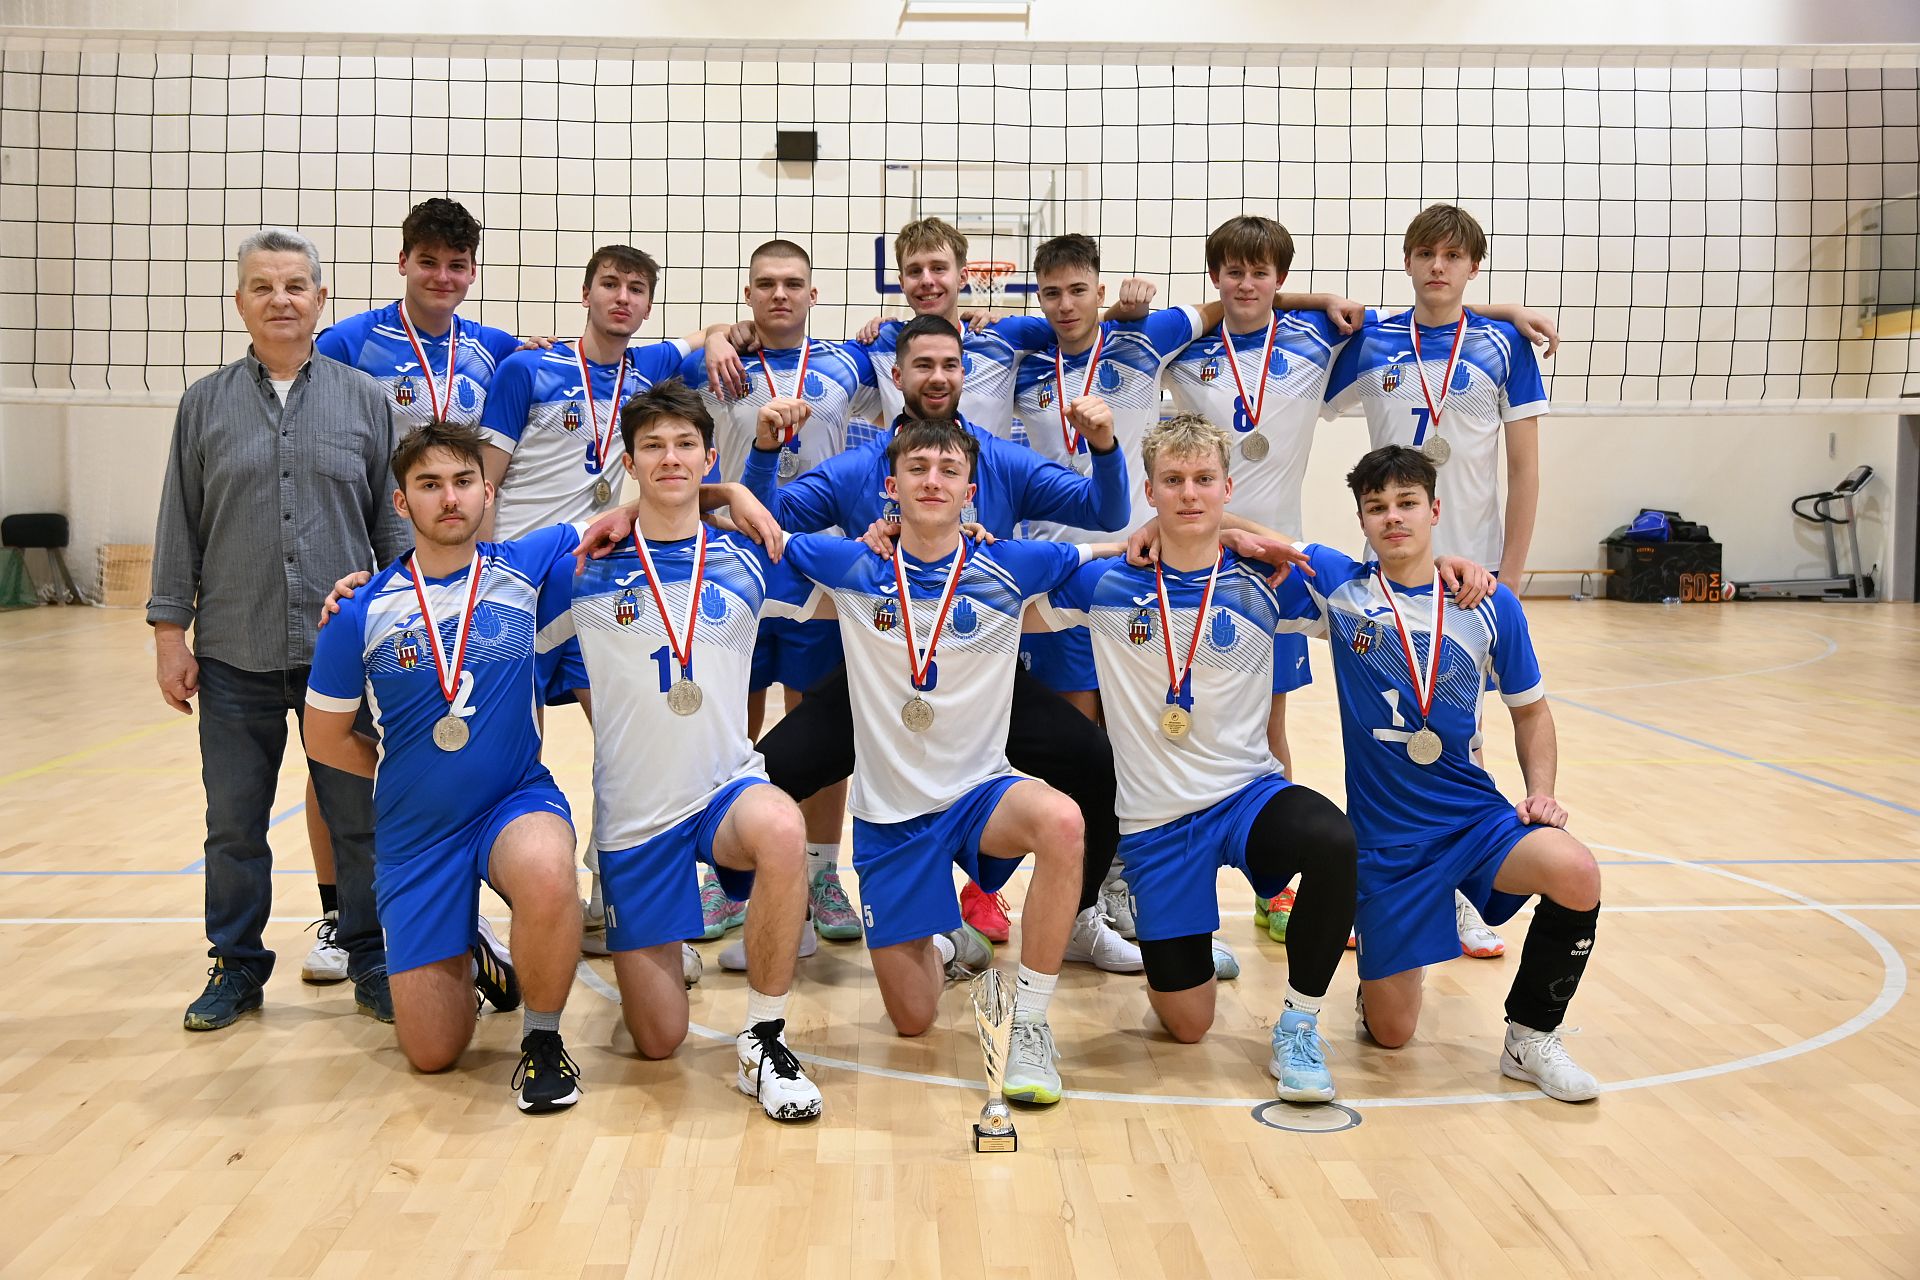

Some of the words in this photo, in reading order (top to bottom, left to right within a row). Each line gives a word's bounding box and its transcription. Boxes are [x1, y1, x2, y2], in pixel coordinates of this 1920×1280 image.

[1233, 394, 1255, 432] 8
[1411, 408, 1430, 446] 7
[585, 437, 603, 475] 9
[1679, 573, 1707, 602] 60
[450, 670, 477, 717] 2
[1165, 668, 1194, 713] 4
[863, 904, 875, 928] 5
